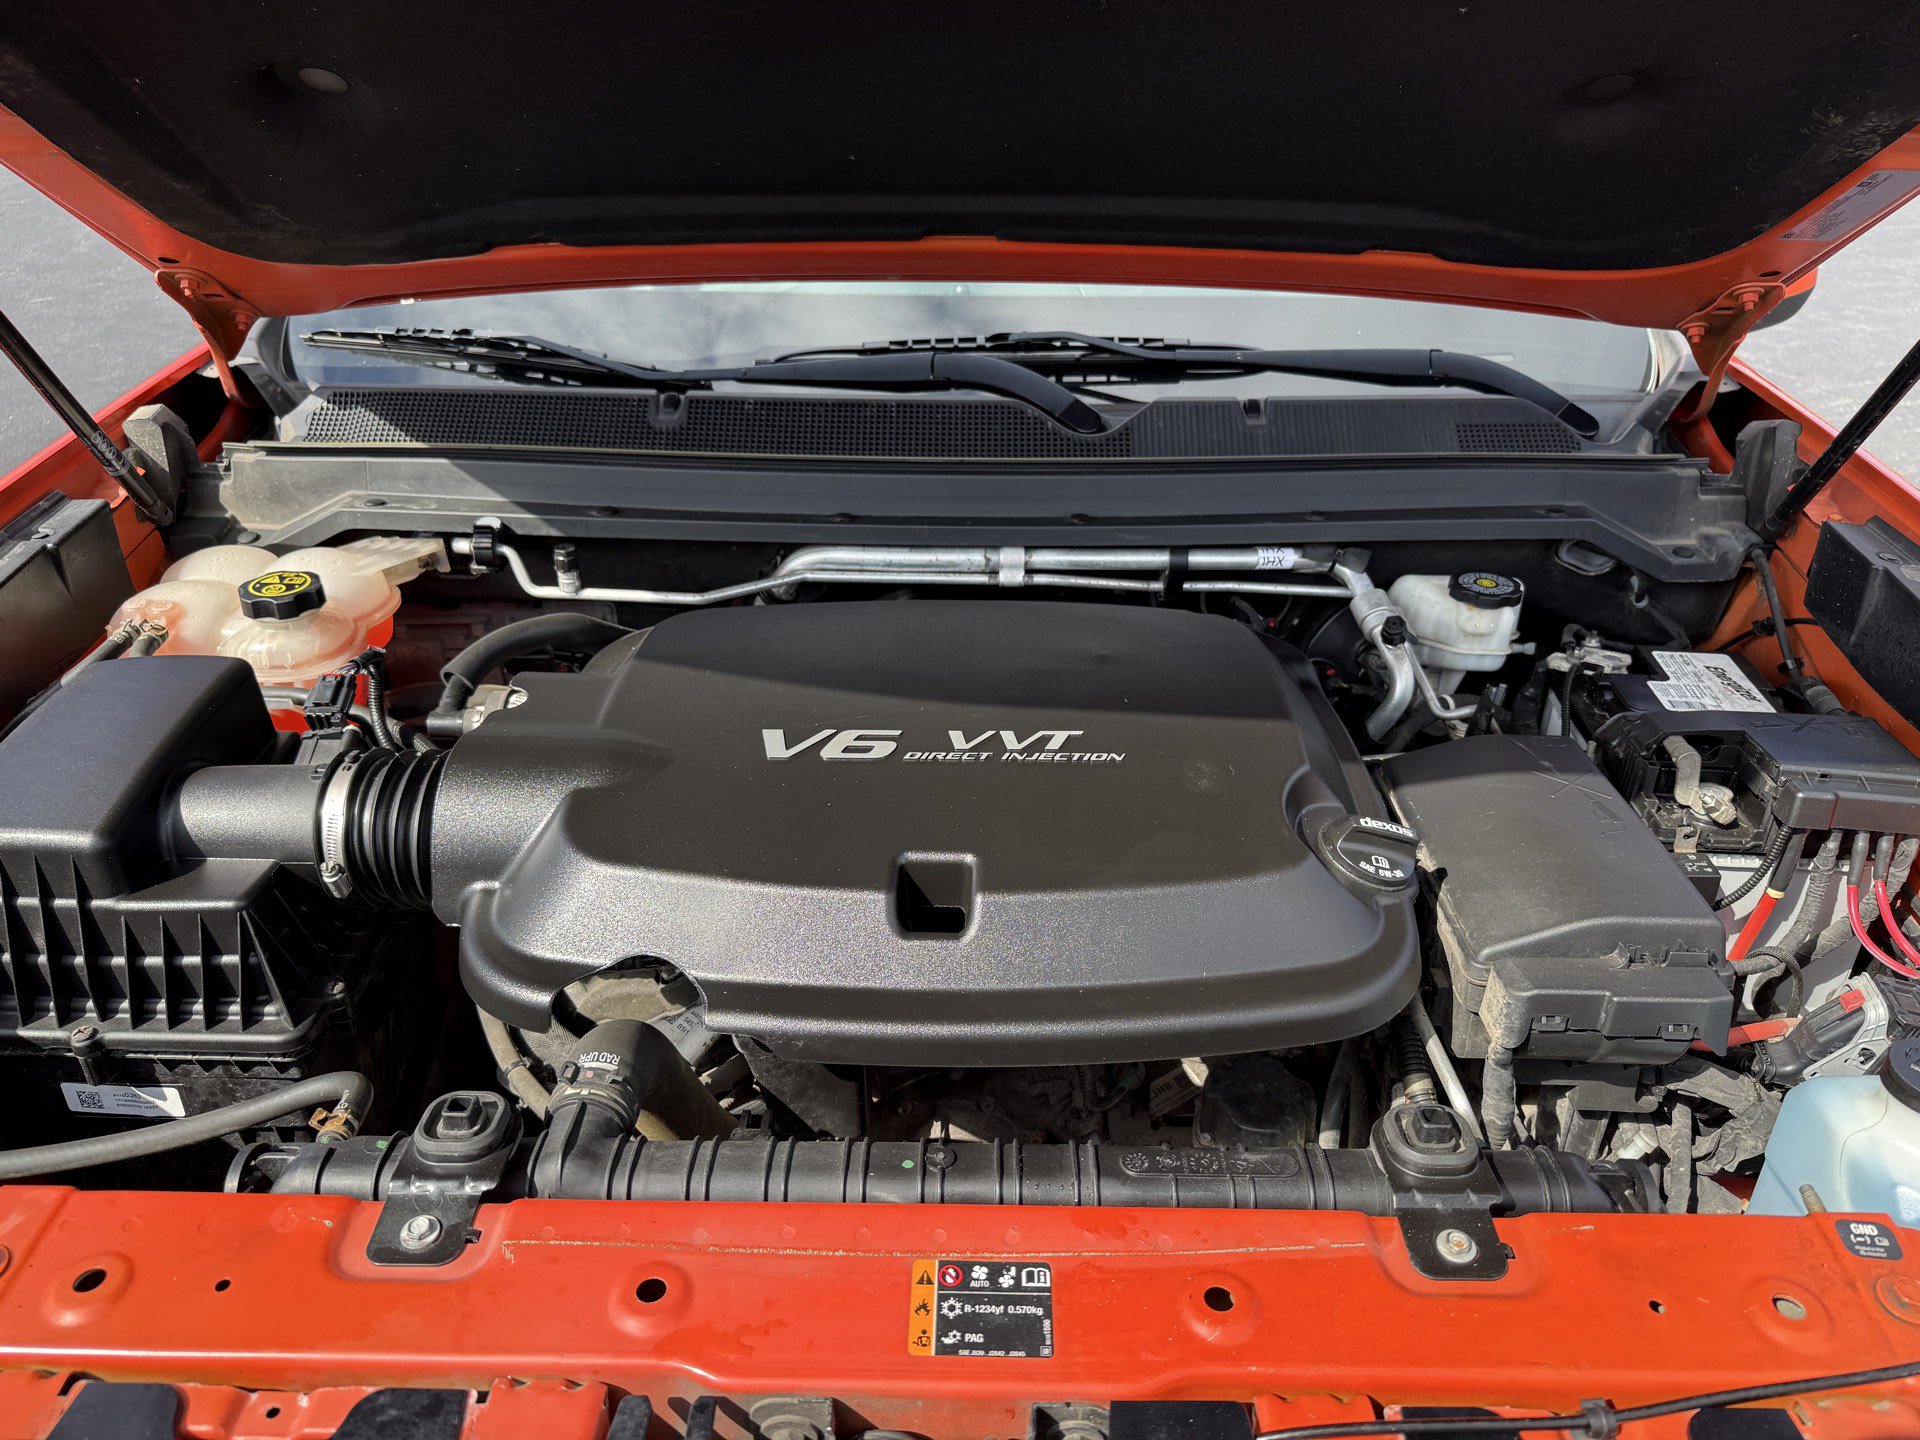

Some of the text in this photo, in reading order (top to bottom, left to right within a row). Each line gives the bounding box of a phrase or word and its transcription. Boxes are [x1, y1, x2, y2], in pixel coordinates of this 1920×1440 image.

[1704, 665, 1761, 702] Energizer
[762, 728, 1084, 760] V6 VVT
[902, 751, 1126, 762] DIRECT INJECTION
[1360, 817, 1414, 837] dexos
[1359, 861, 1376, 873] SAE
[579, 1051, 620, 1065] RAD UPR
[970, 1280, 990, 1288] AUTO
[964, 1305, 1044, 1316] R-1234yf 0.570kg
[964, 1332, 984, 1343] PAG
